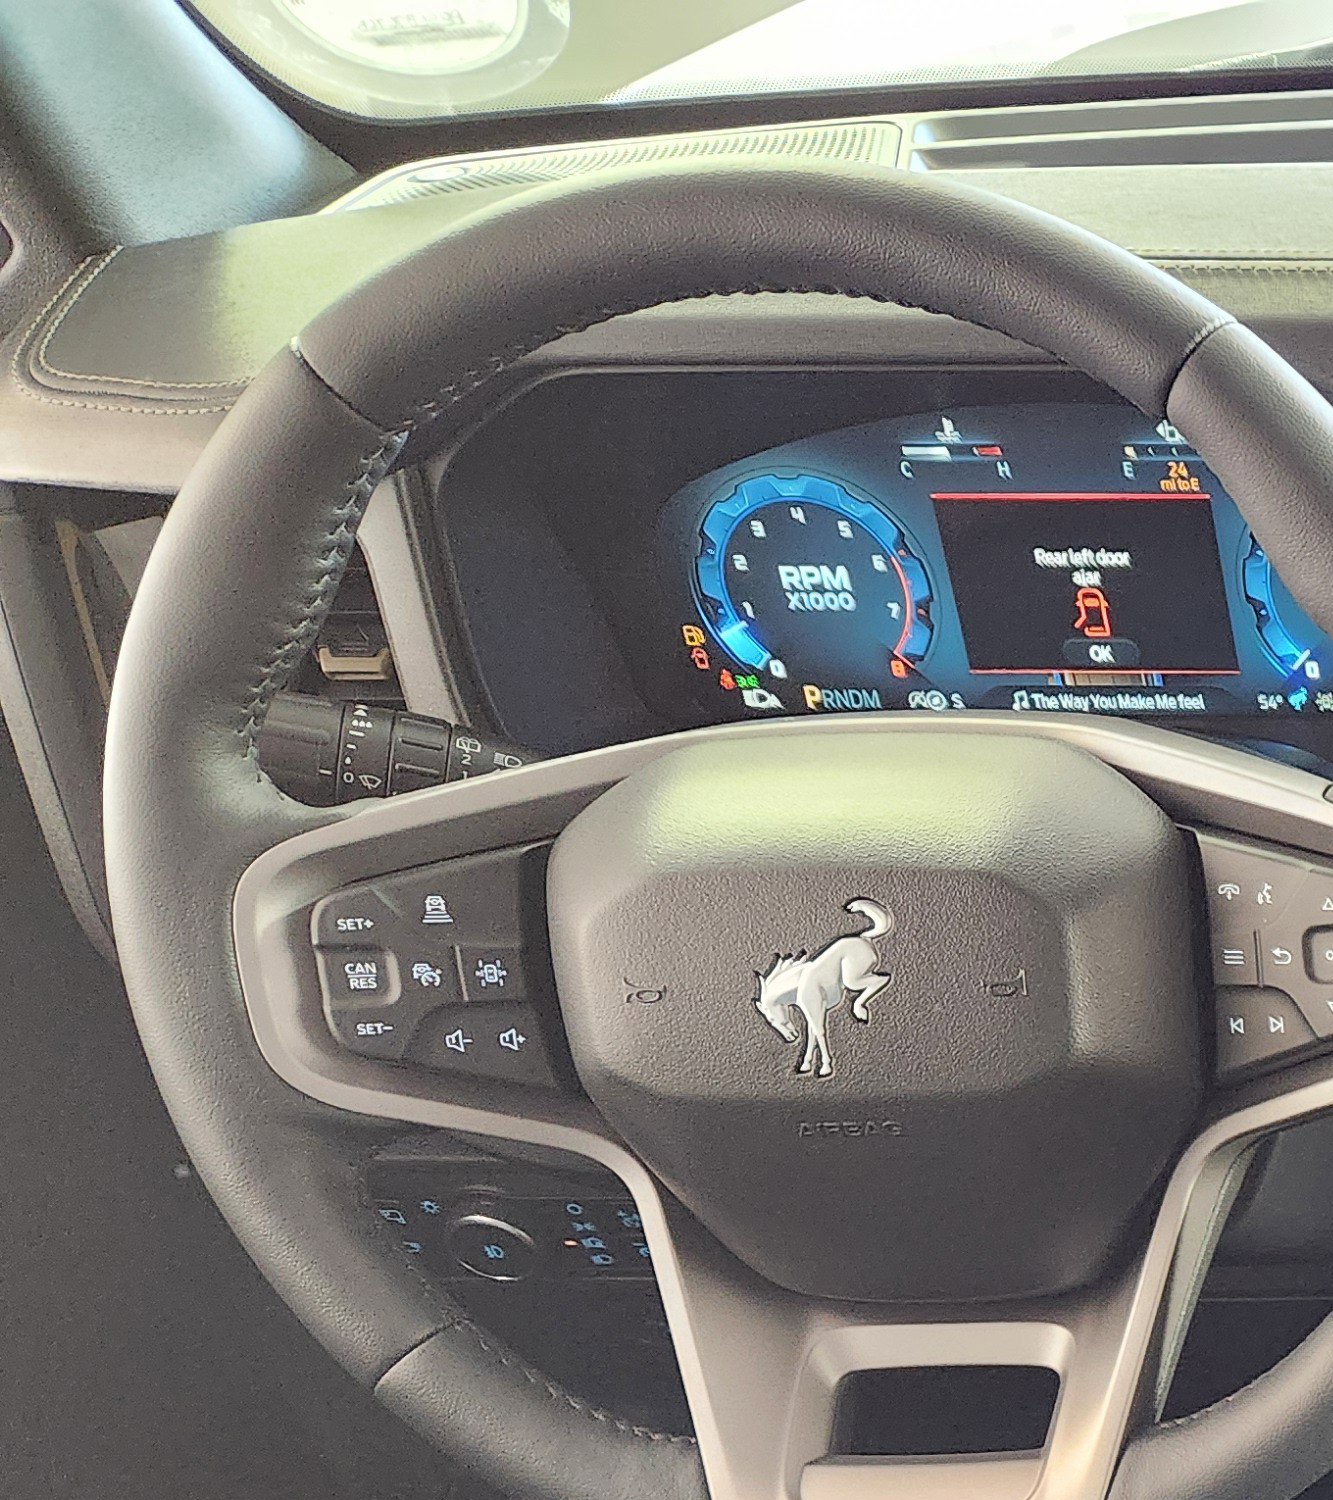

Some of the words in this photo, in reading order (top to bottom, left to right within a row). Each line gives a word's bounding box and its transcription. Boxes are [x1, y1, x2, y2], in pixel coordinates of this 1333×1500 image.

[900, 461, 914, 479] C
[996, 461, 1013, 479] H
[1123, 461, 1135, 478] E
[1167, 461, 1189, 478] 24
[789, 507, 807, 525] 4
[750, 520, 767, 538] 3
[837, 520, 853, 539] 5
[732, 554, 750, 571] 2
[871, 554, 888, 573] 6
[1033, 549, 1072, 568] Rear
[1072, 548, 1097, 568] left
[1097, 548, 1131, 567] door
[778, 565, 853, 591] RPM
[741, 601, 755, 619] 1
[886, 602, 900, 619] 7
[1089, 645, 1117, 662] OK
[769, 659, 788, 679] 0
[1305, 660, 1320, 680] 0
[802, 684, 883, 711] PRNDM
[1033, 693, 1056, 711] The
[1057, 693, 1087, 712] Way
[1088, 692, 1117, 711] You
[1118, 692, 1153, 711] Make
[1153, 692, 1176, 711] Me
[1177, 692, 1205, 710] feel
[461, 753, 472, 765] 2
[344, 962, 377, 975] CAN
[349, 977, 378, 990] RES
